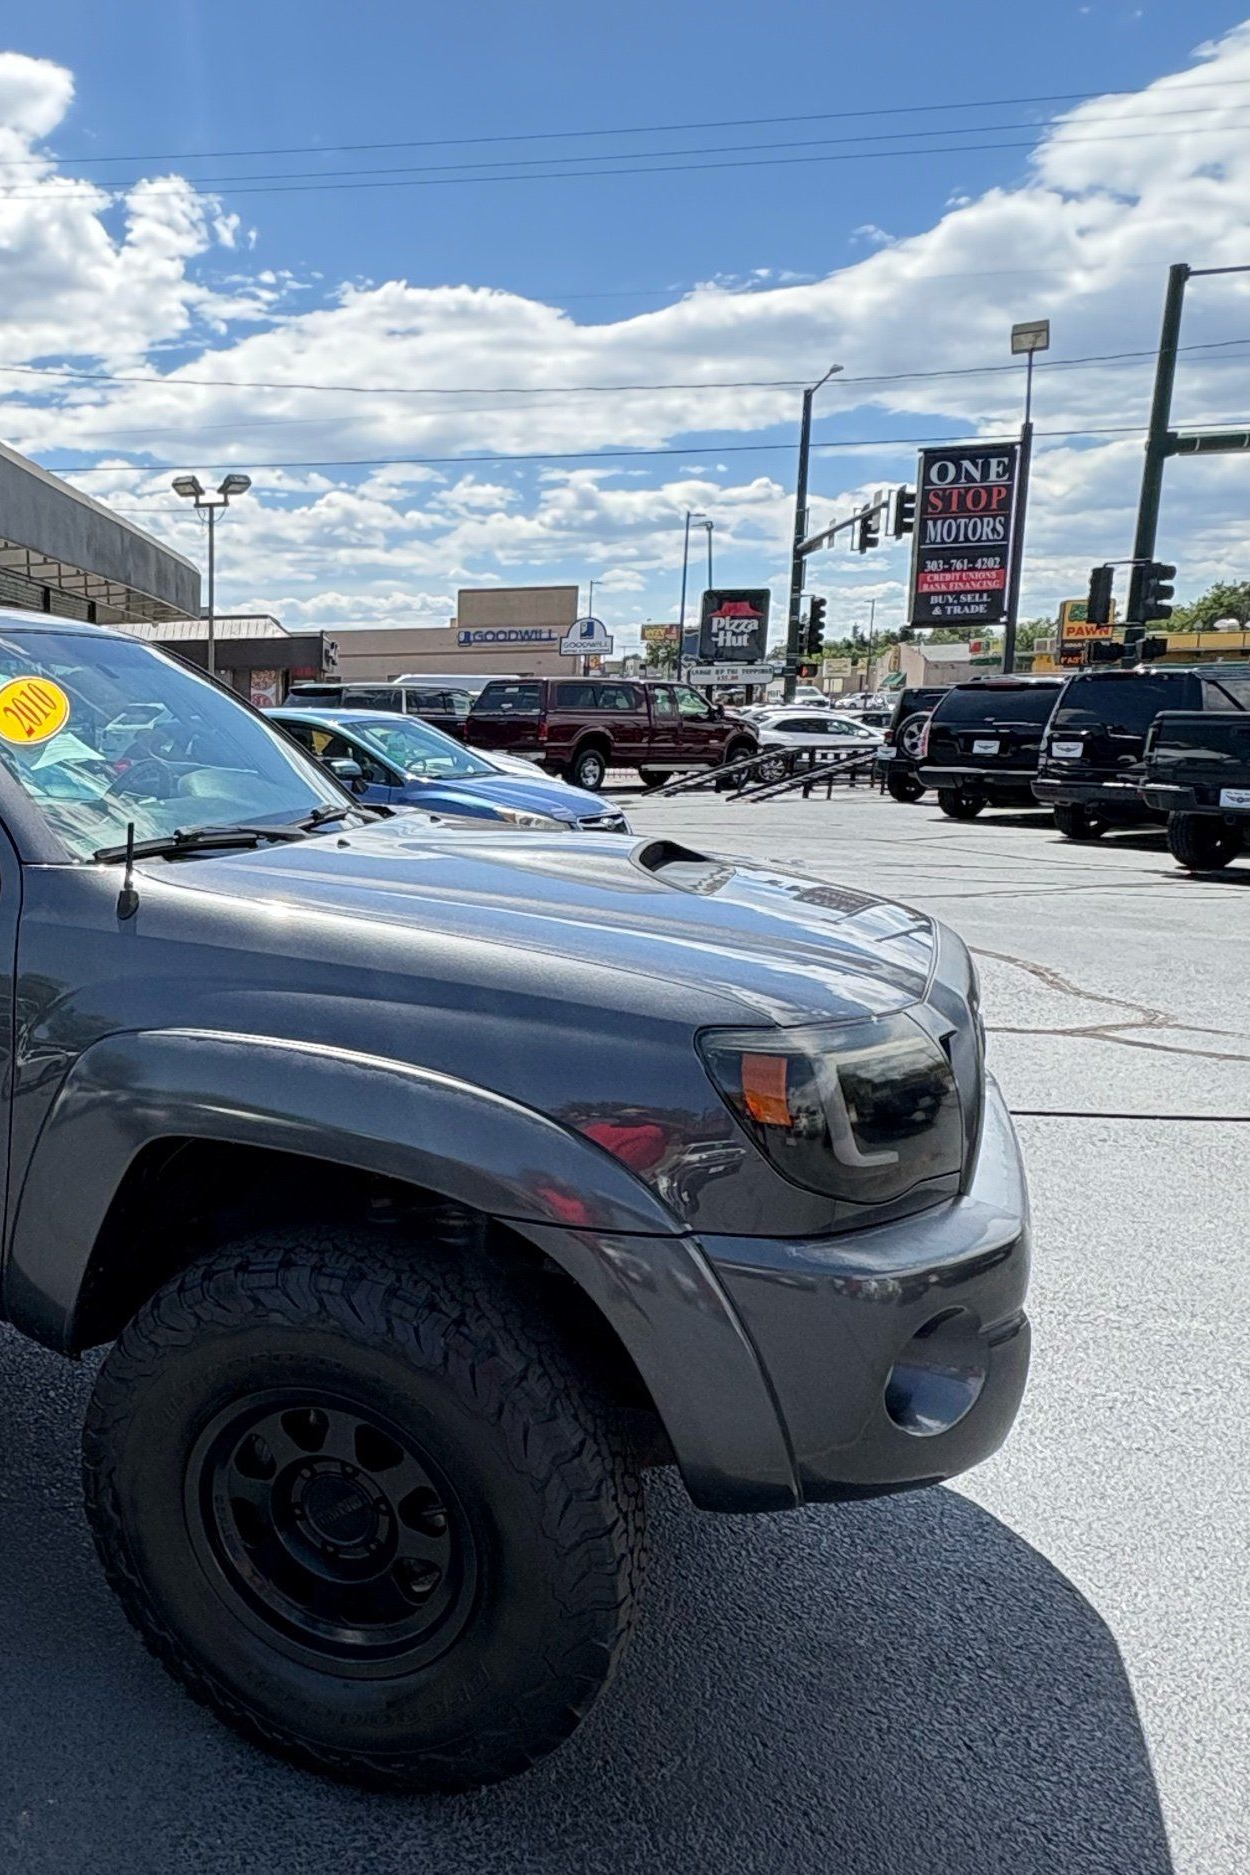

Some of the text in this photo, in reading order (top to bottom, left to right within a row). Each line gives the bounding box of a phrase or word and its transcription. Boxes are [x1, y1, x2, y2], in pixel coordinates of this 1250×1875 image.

[929, 457, 1010, 485] ONE
[927, 486, 1007, 513] STOP
[925, 516, 1005, 544] MOTORS
[926, 571, 996, 582] CREDIT UNIONS
[922, 580, 999, 592] BANK FINANCING
[959, 593, 991, 602] SELL
[932, 604, 987, 615] & TRADE
[711, 616, 759, 633] Pizza
[473, 629, 557, 642] GOODWILL
[1066, 626, 1109, 637] PAWN
[563, 641, 609, 649] GOODWILL
[711, 631, 750, 647] Hut
[3, 682, 57, 738] 2010
